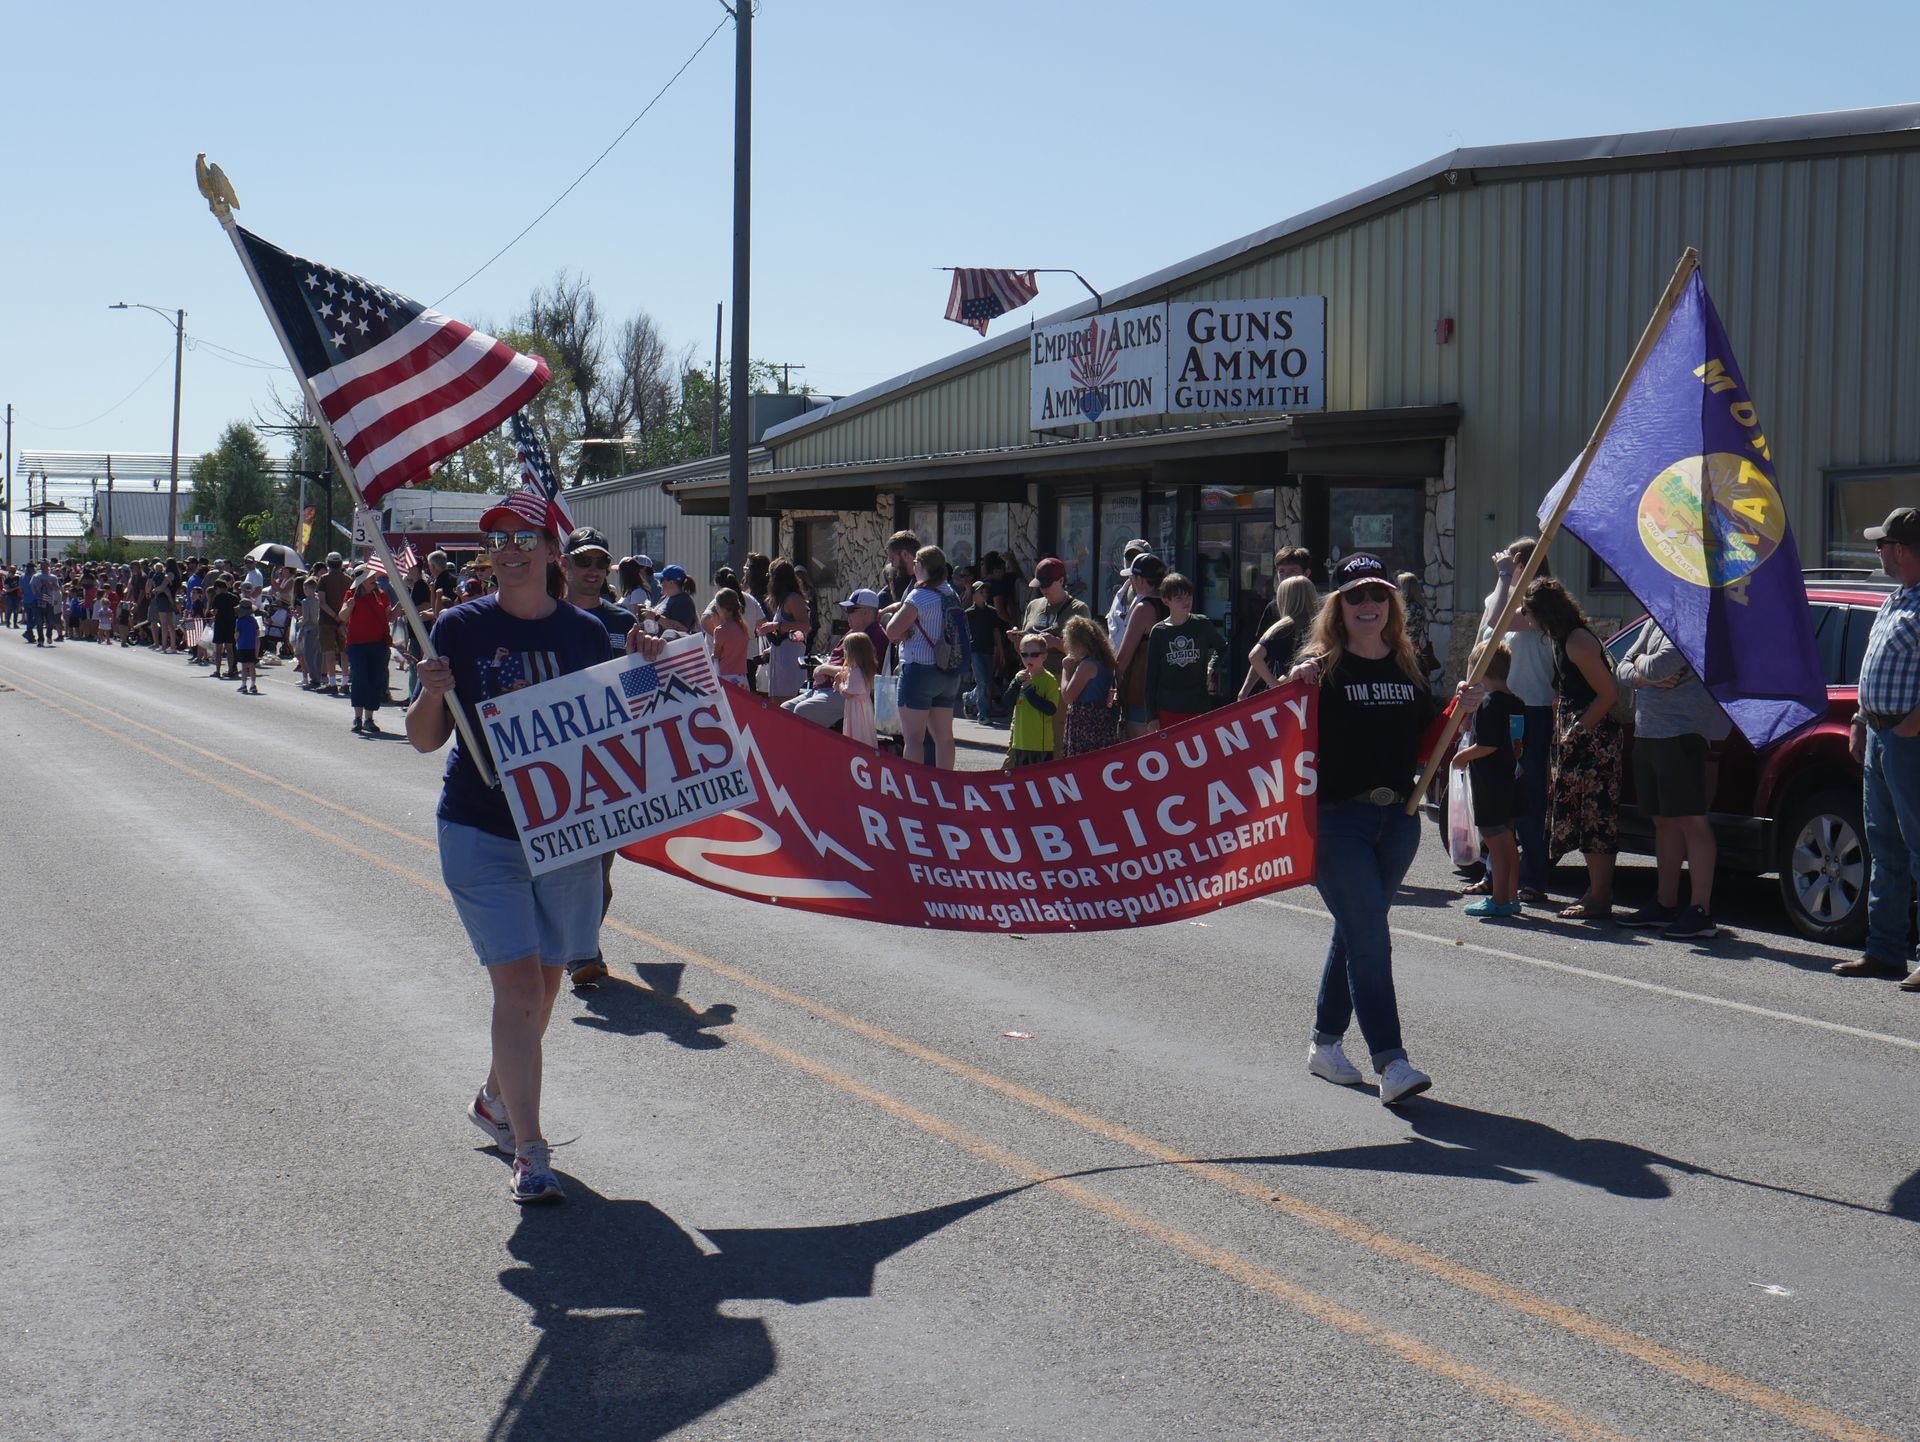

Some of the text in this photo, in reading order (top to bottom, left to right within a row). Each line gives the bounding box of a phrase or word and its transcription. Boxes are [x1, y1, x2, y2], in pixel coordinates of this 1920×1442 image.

[1033, 313, 1162, 365] EMPIRE ARMS
[1187, 307, 1293, 344] GUNS
[1178, 346, 1307, 382] AMMO
[1041, 376, 1153, 420] AMMUNITION
[1174, 385, 1309, 408] GUNSMITH
[1646, 521, 1660, 537] ORO
[1343, 556, 1382, 572] TRUMP
[1167, 649, 1200, 660] FUSION
[1344, 682, 1415, 702] TIM SHEEHY
[489, 685, 633, 763] MARLA
[504, 703, 734, 832] DAVIS
[850, 695, 1309, 813] GALLATIN COUNTY
[529, 818, 600, 863] STATE
[599, 769, 749, 841] LEGISLATURE
[857, 750, 1319, 864] REPUBLICANS
[907, 812, 1290, 891] FIGHTING FOR YOUR LIBERTY
[923, 854, 1293, 929] www.gallatinrepublicans.com
